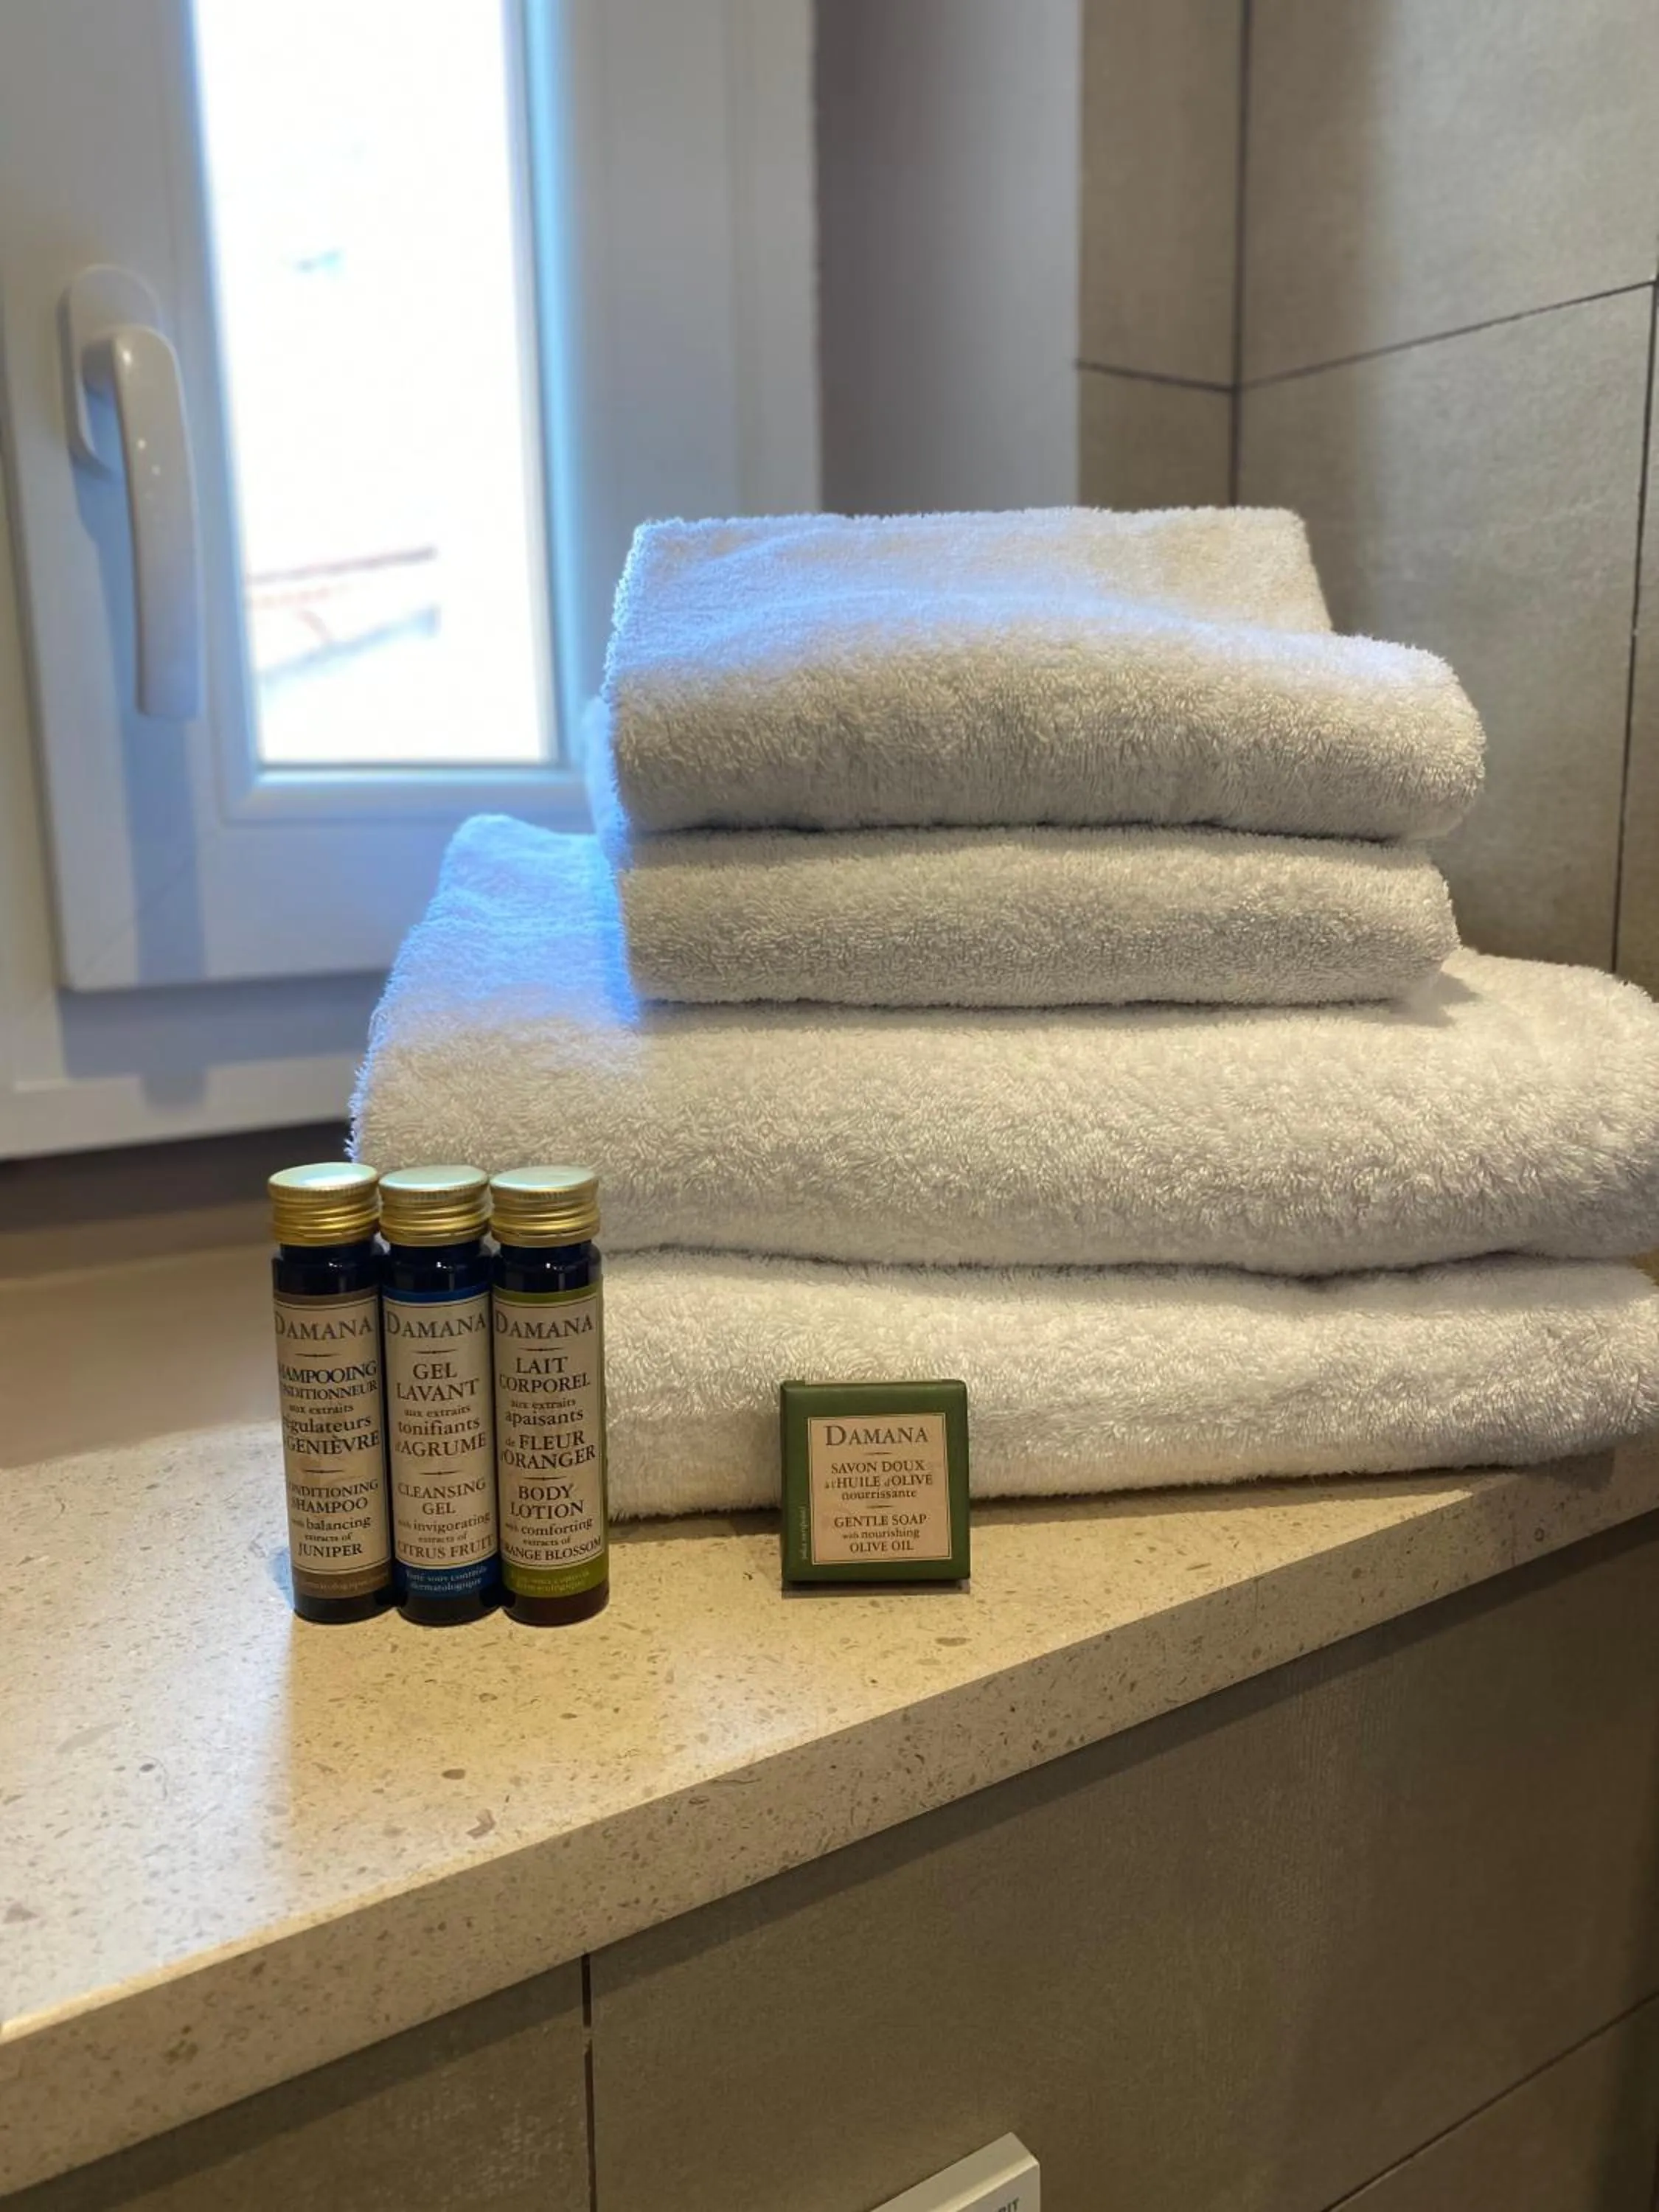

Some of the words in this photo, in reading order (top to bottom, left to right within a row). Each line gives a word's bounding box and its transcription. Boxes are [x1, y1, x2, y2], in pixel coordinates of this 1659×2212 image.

[274, 1310, 373, 1340] DAMANA
[386, 1310, 487, 1339] DAMANA
[495, 1310, 594, 1340] DAMANA
[279, 1360, 377, 1384] HAMPOOING
[412, 1363, 458, 1380] GEL
[516, 1356, 568, 1374] LAIT
[282, 1380, 378, 1400] NDITIONNEUR
[396, 1377, 480, 1402] LAVANT
[499, 1371, 590, 1394] CORPOREL
[308, 1403, 354, 1415] extraits
[426, 1405, 471, 1418] extraits
[532, 1397, 576, 1410] extraits
[398, 1417, 480, 1436] tonifiants
[505, 1409, 583, 1427] apaisants
[518, 1430, 585, 1451] FLEUR
[824, 1425, 929, 1446] DAMANA
[831, 1461, 877, 1475] SAVON
[882, 1459, 925, 1472] DOUX
[290, 1479, 378, 1498] NDITIONING
[397, 1477, 486, 1499] CLEANSING
[518, 1482, 574, 1500] BODY
[841, 1488, 917, 1501] nourrissante
[422, 1502, 456, 1515] GEL
[510, 1500, 584, 1520] LOTION
[307, 1517, 371, 1531] balancing
[413, 1512, 490, 1534] invigorating
[521, 1518, 593, 1537] comforting
[834, 1515, 888, 1528] GENTLE
[891, 1513, 927, 1525] SOAP
[341, 1531, 352, 1542] of
[560, 1535, 571, 1545] of
[861, 1526, 920, 1540] nourishing
[298, 1542, 363, 1558] JUNIPER
[397, 1540, 446, 1559] CITRUS
[504, 1540, 542, 1561] ANGE
[849, 1541, 888, 1554] OLIVE
[891, 1540, 914, 1551] OIL
